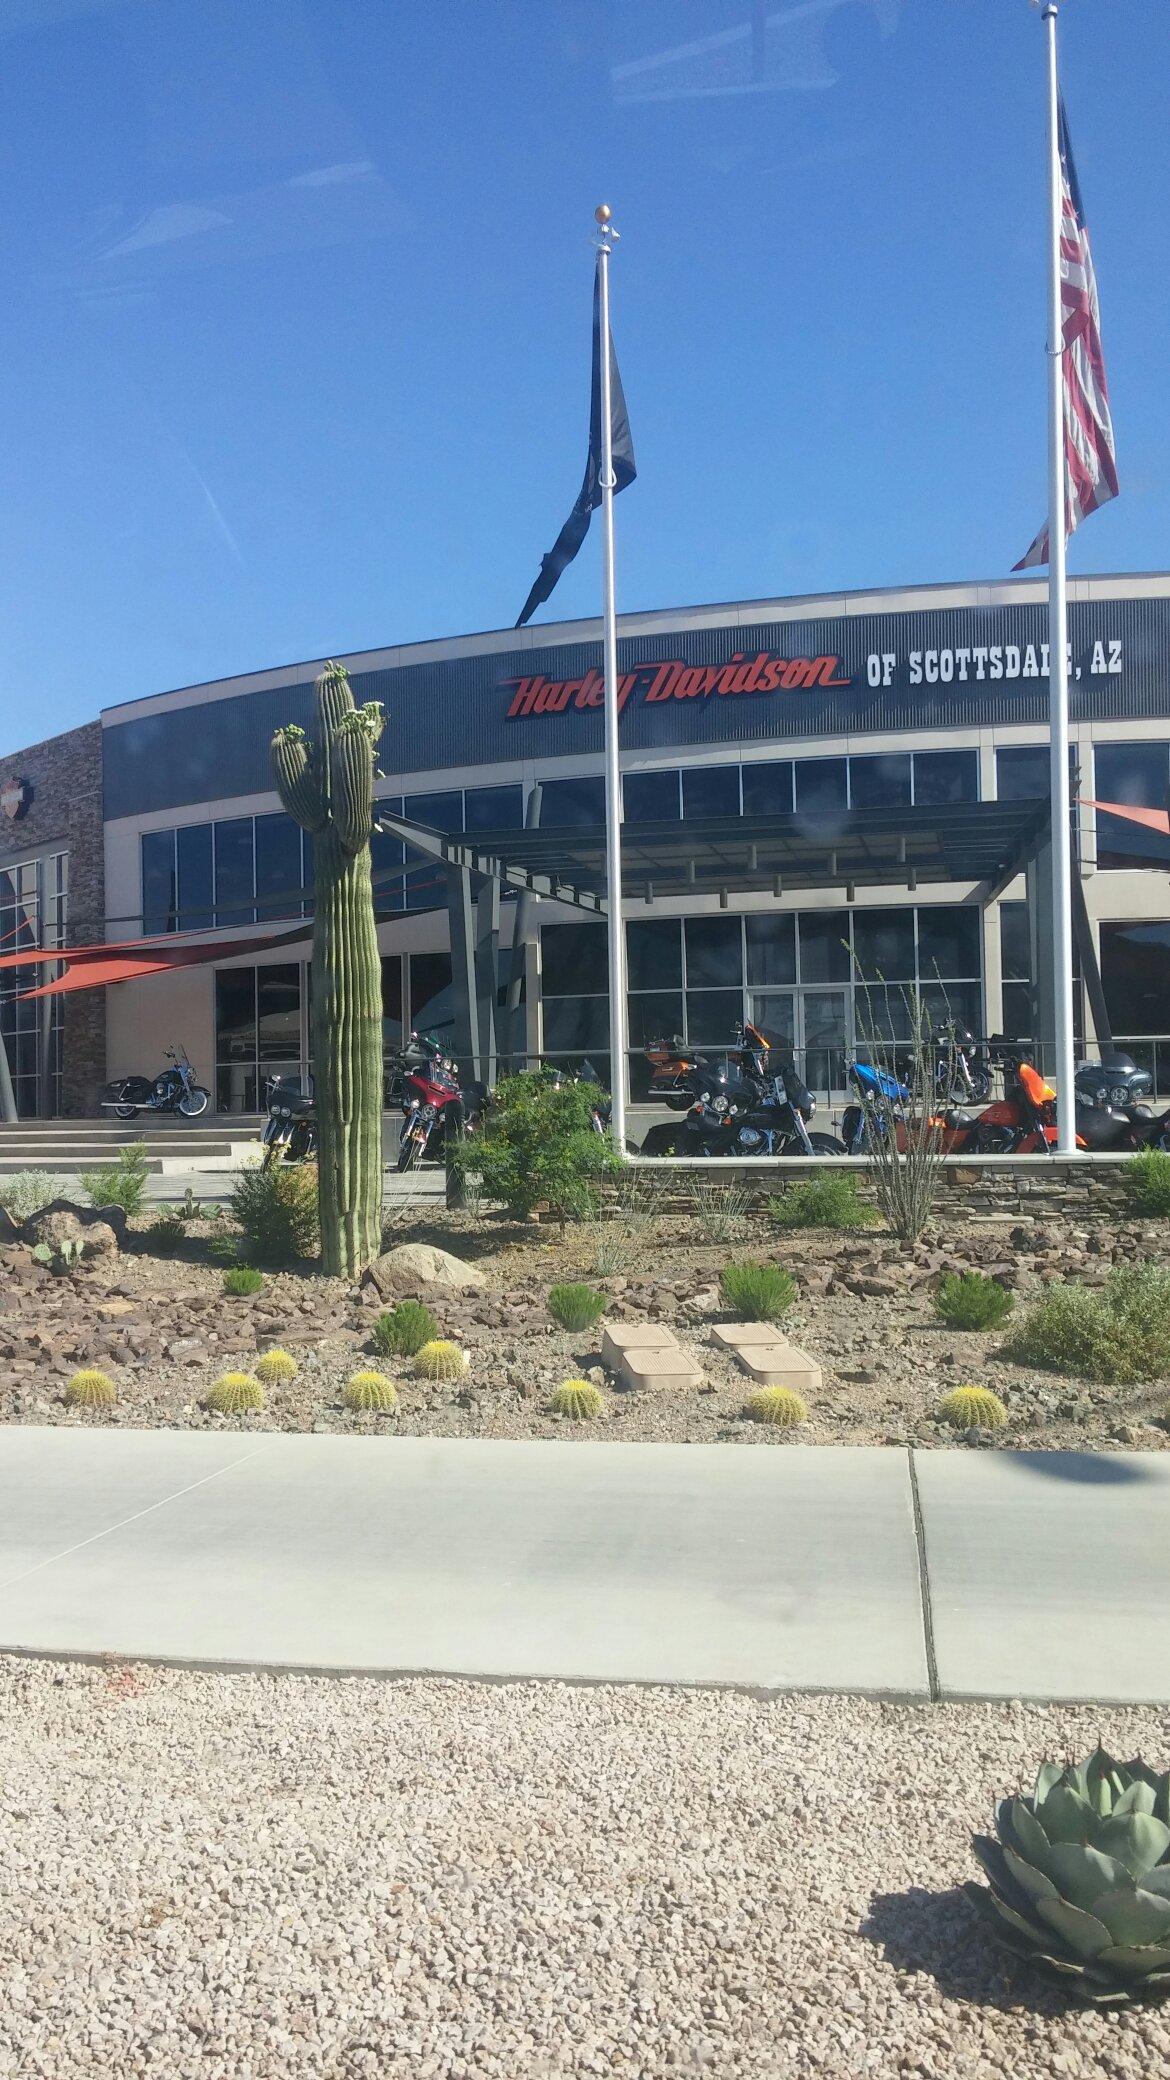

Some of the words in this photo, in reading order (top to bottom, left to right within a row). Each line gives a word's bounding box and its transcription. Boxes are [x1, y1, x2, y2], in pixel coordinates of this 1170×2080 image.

[499, 653, 851, 716] Harley-Davidson
[866, 653, 896, 687] OF
[1090, 640, 1122, 674] AZ
